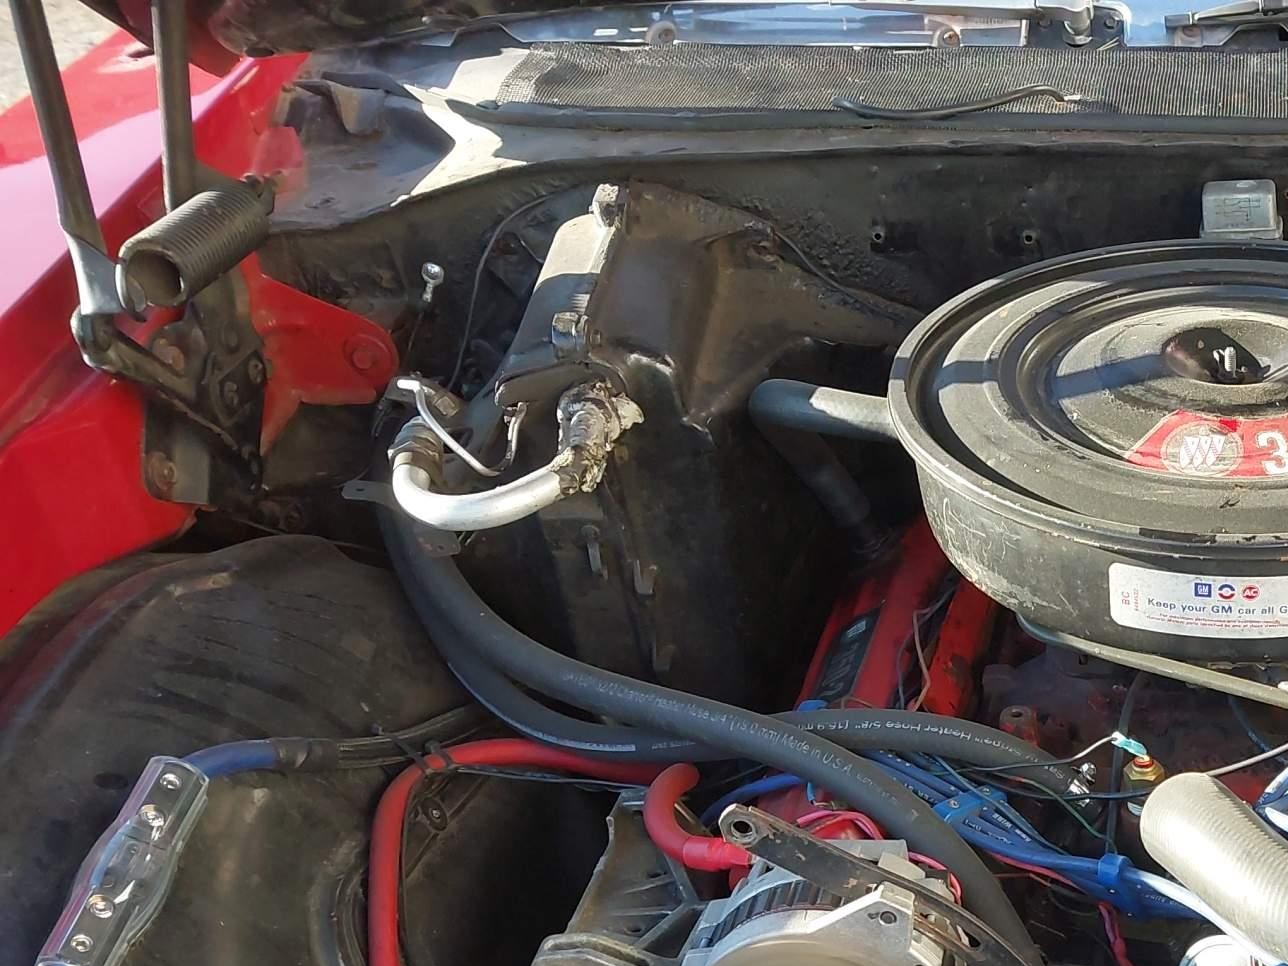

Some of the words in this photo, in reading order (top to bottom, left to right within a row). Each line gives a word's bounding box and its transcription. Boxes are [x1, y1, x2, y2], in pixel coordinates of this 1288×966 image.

[1197, 584, 1209, 595] GM
[1243, 587, 1259, 598] AC
[1147, 598, 1176, 611] Keep
[1181, 605, 1206, 615] your
[1211, 605, 1233, 615] GM
[1238, 607, 1257, 615] car
[1260, 604, 1274, 615] all
[886, 721, 921, 732] Hose
[924, 726, 971, 741] Heater
[780, 732, 810, 755] Made
[811, 749, 821, 759] in
